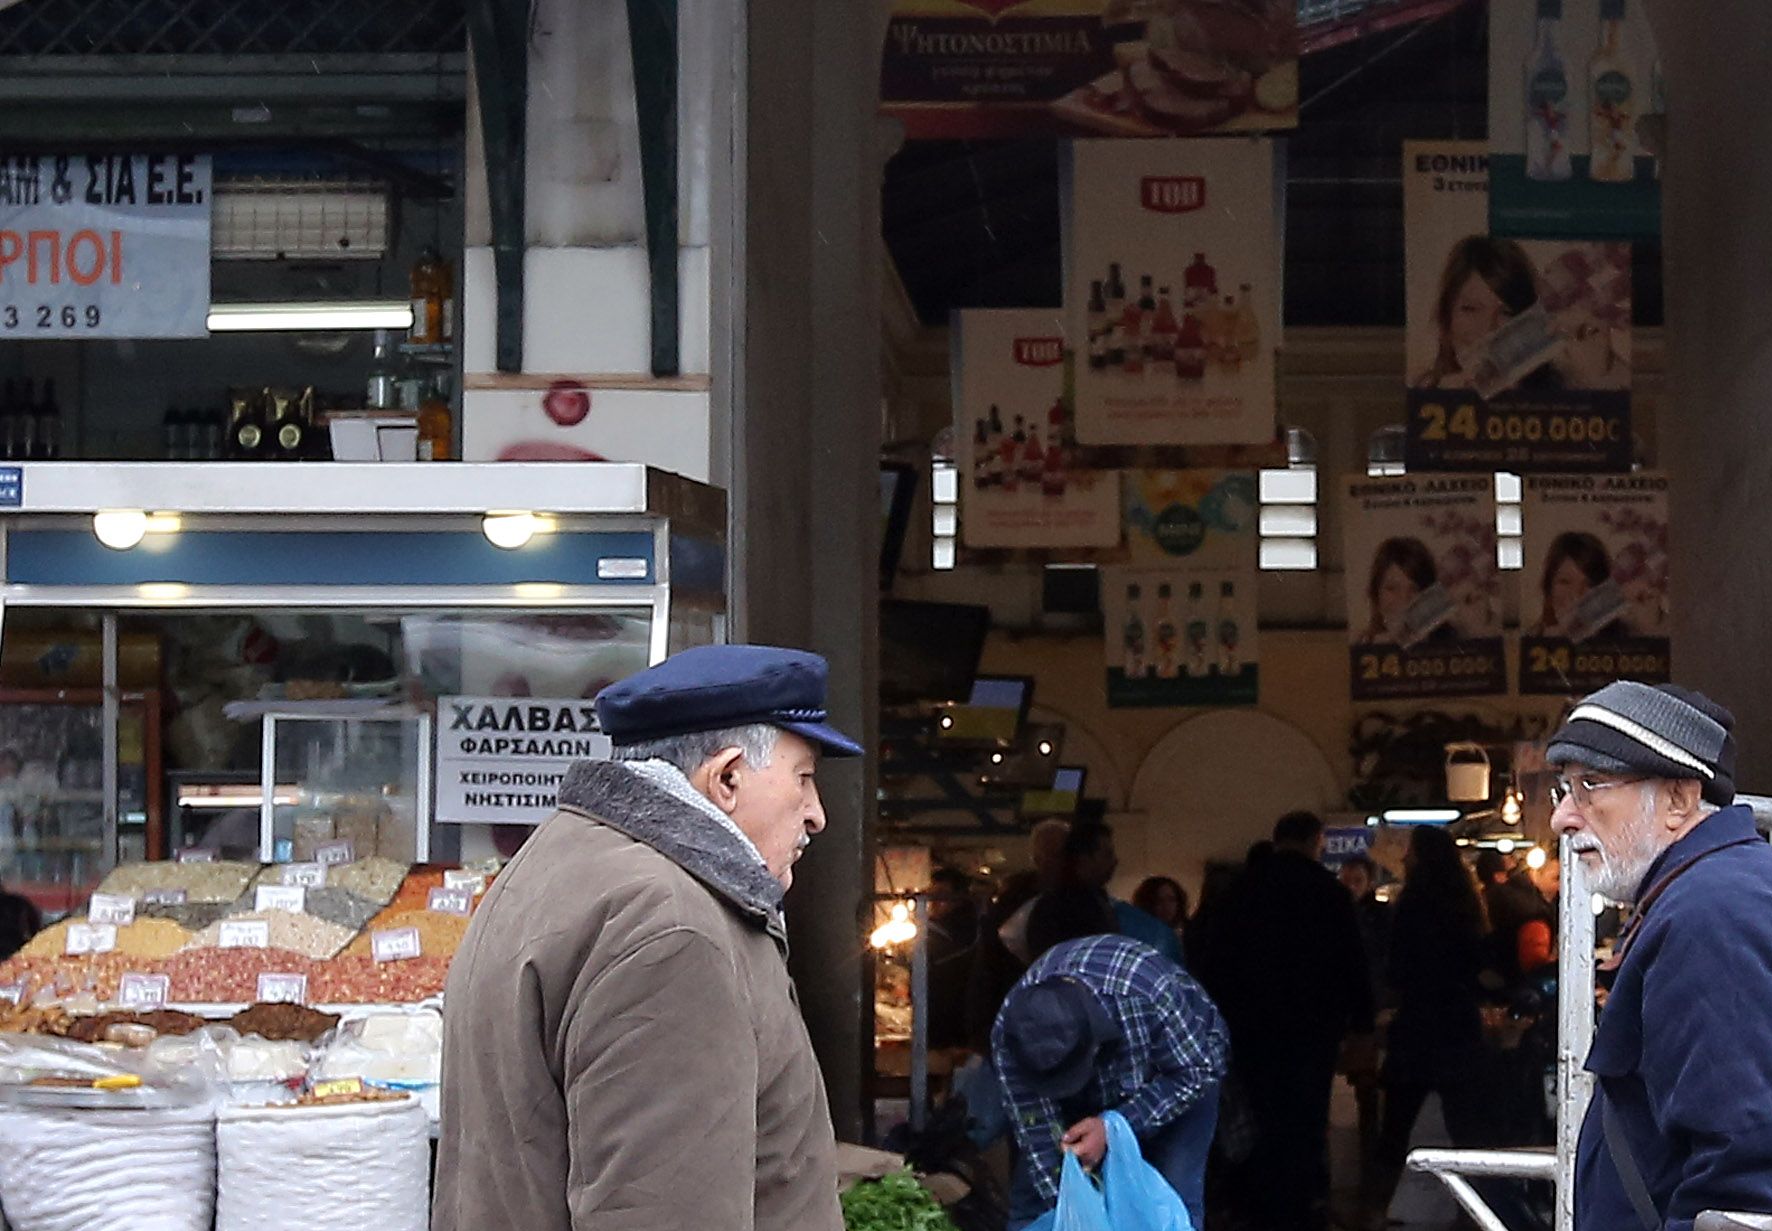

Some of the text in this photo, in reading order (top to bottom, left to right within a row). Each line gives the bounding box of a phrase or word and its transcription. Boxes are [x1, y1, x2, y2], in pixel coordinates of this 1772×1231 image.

[86, 155, 135, 204] ΣΙΑ
[147, 156, 203, 204] Ε.Ε.
[36, 305, 100, 328] 269
[450, 705, 600, 733] ΧΑΛΒΑΣ
[460, 738, 590, 756] ΦΑΡΣΑΛΩΝ
[465, 794, 556, 807] ΝΗΣΤΙΣΙΜ
